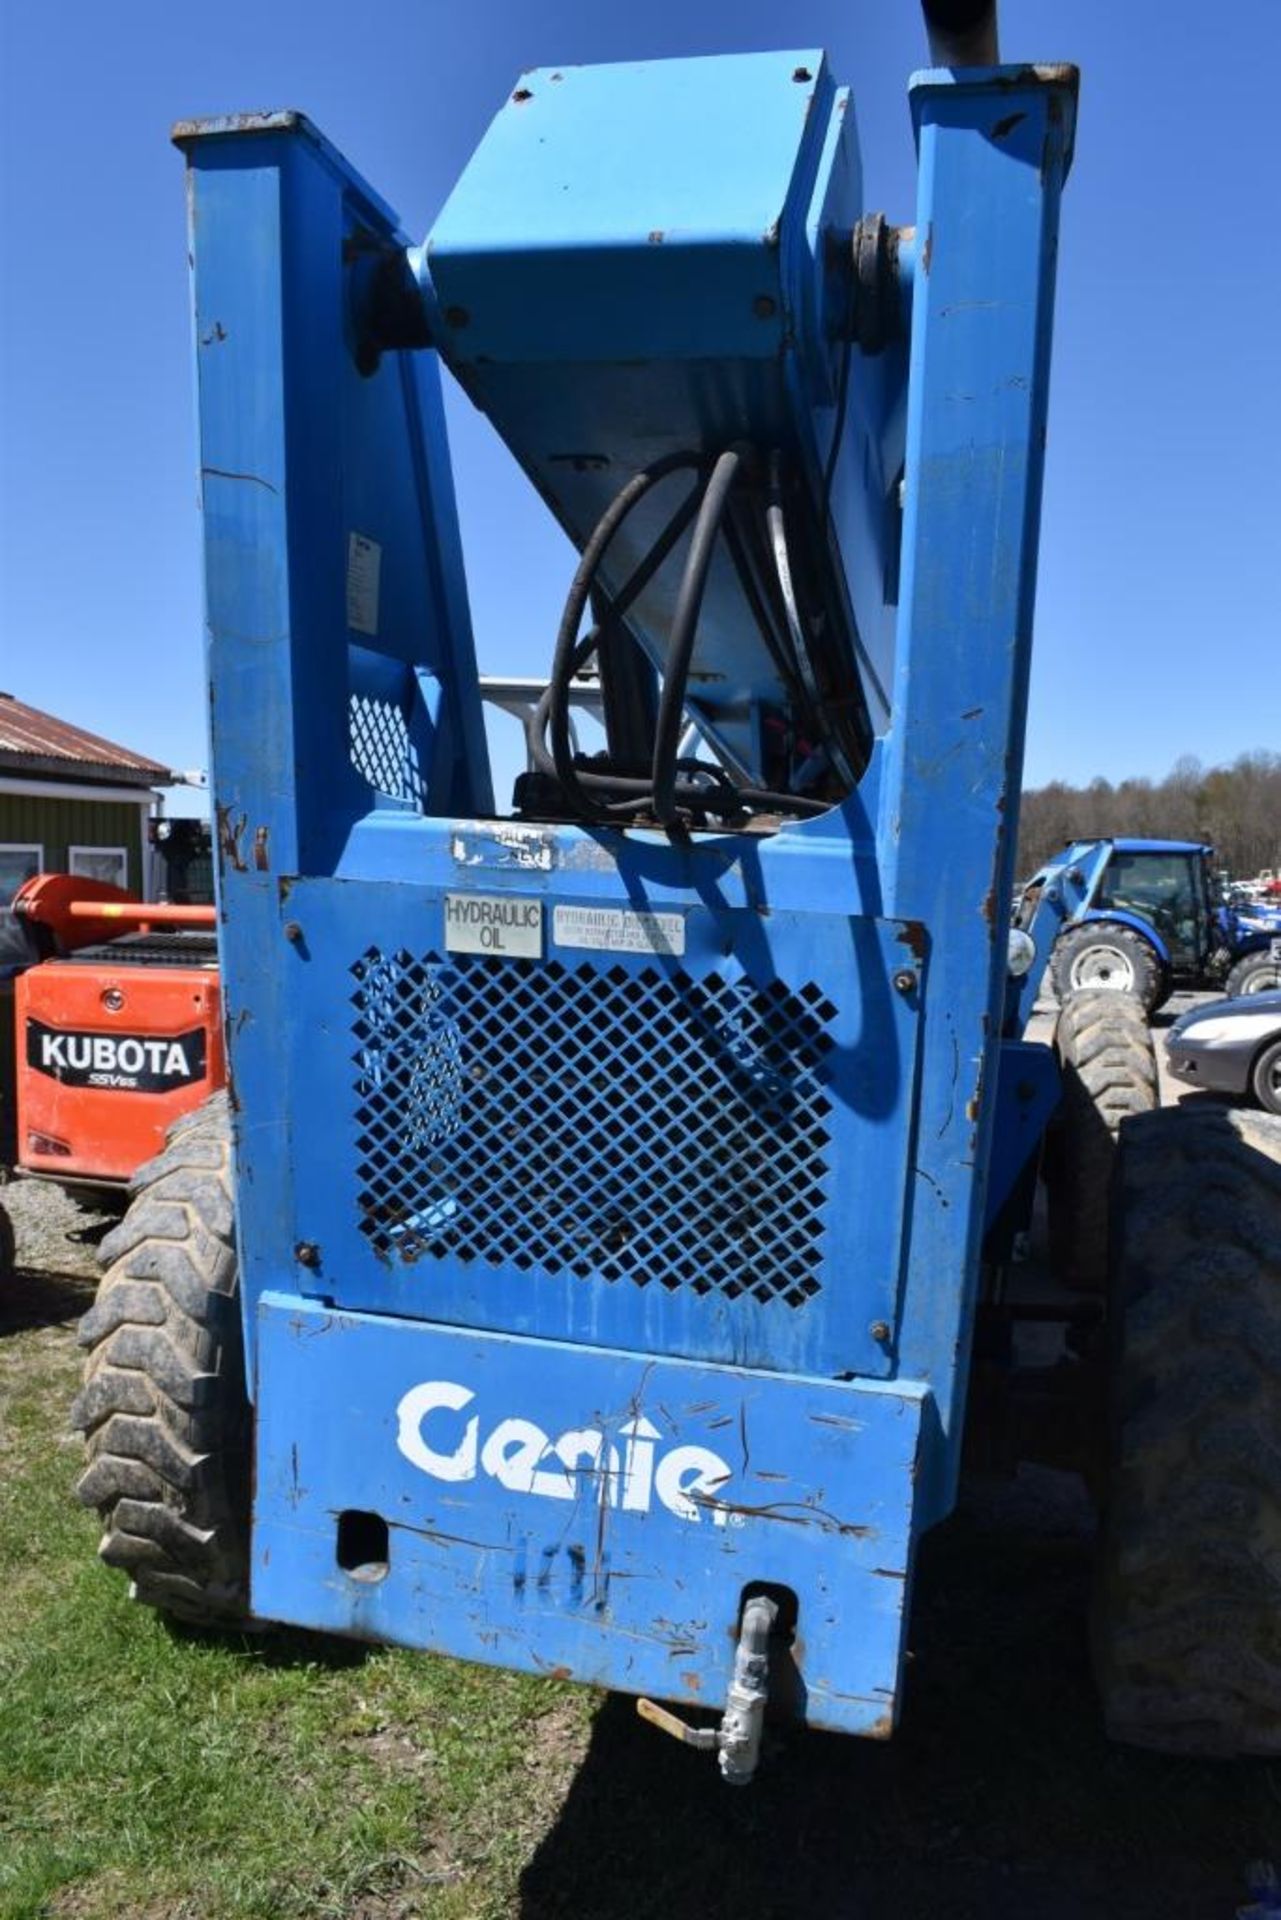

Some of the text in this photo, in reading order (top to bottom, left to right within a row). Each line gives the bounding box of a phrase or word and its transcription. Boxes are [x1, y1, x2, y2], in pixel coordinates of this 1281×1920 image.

[447, 899, 539, 927] HYDRAULIC
[479, 926, 506, 949] OIL
[41, 1034, 191, 1076] KUBOTA
[396, 1380, 733, 1526] Genie
